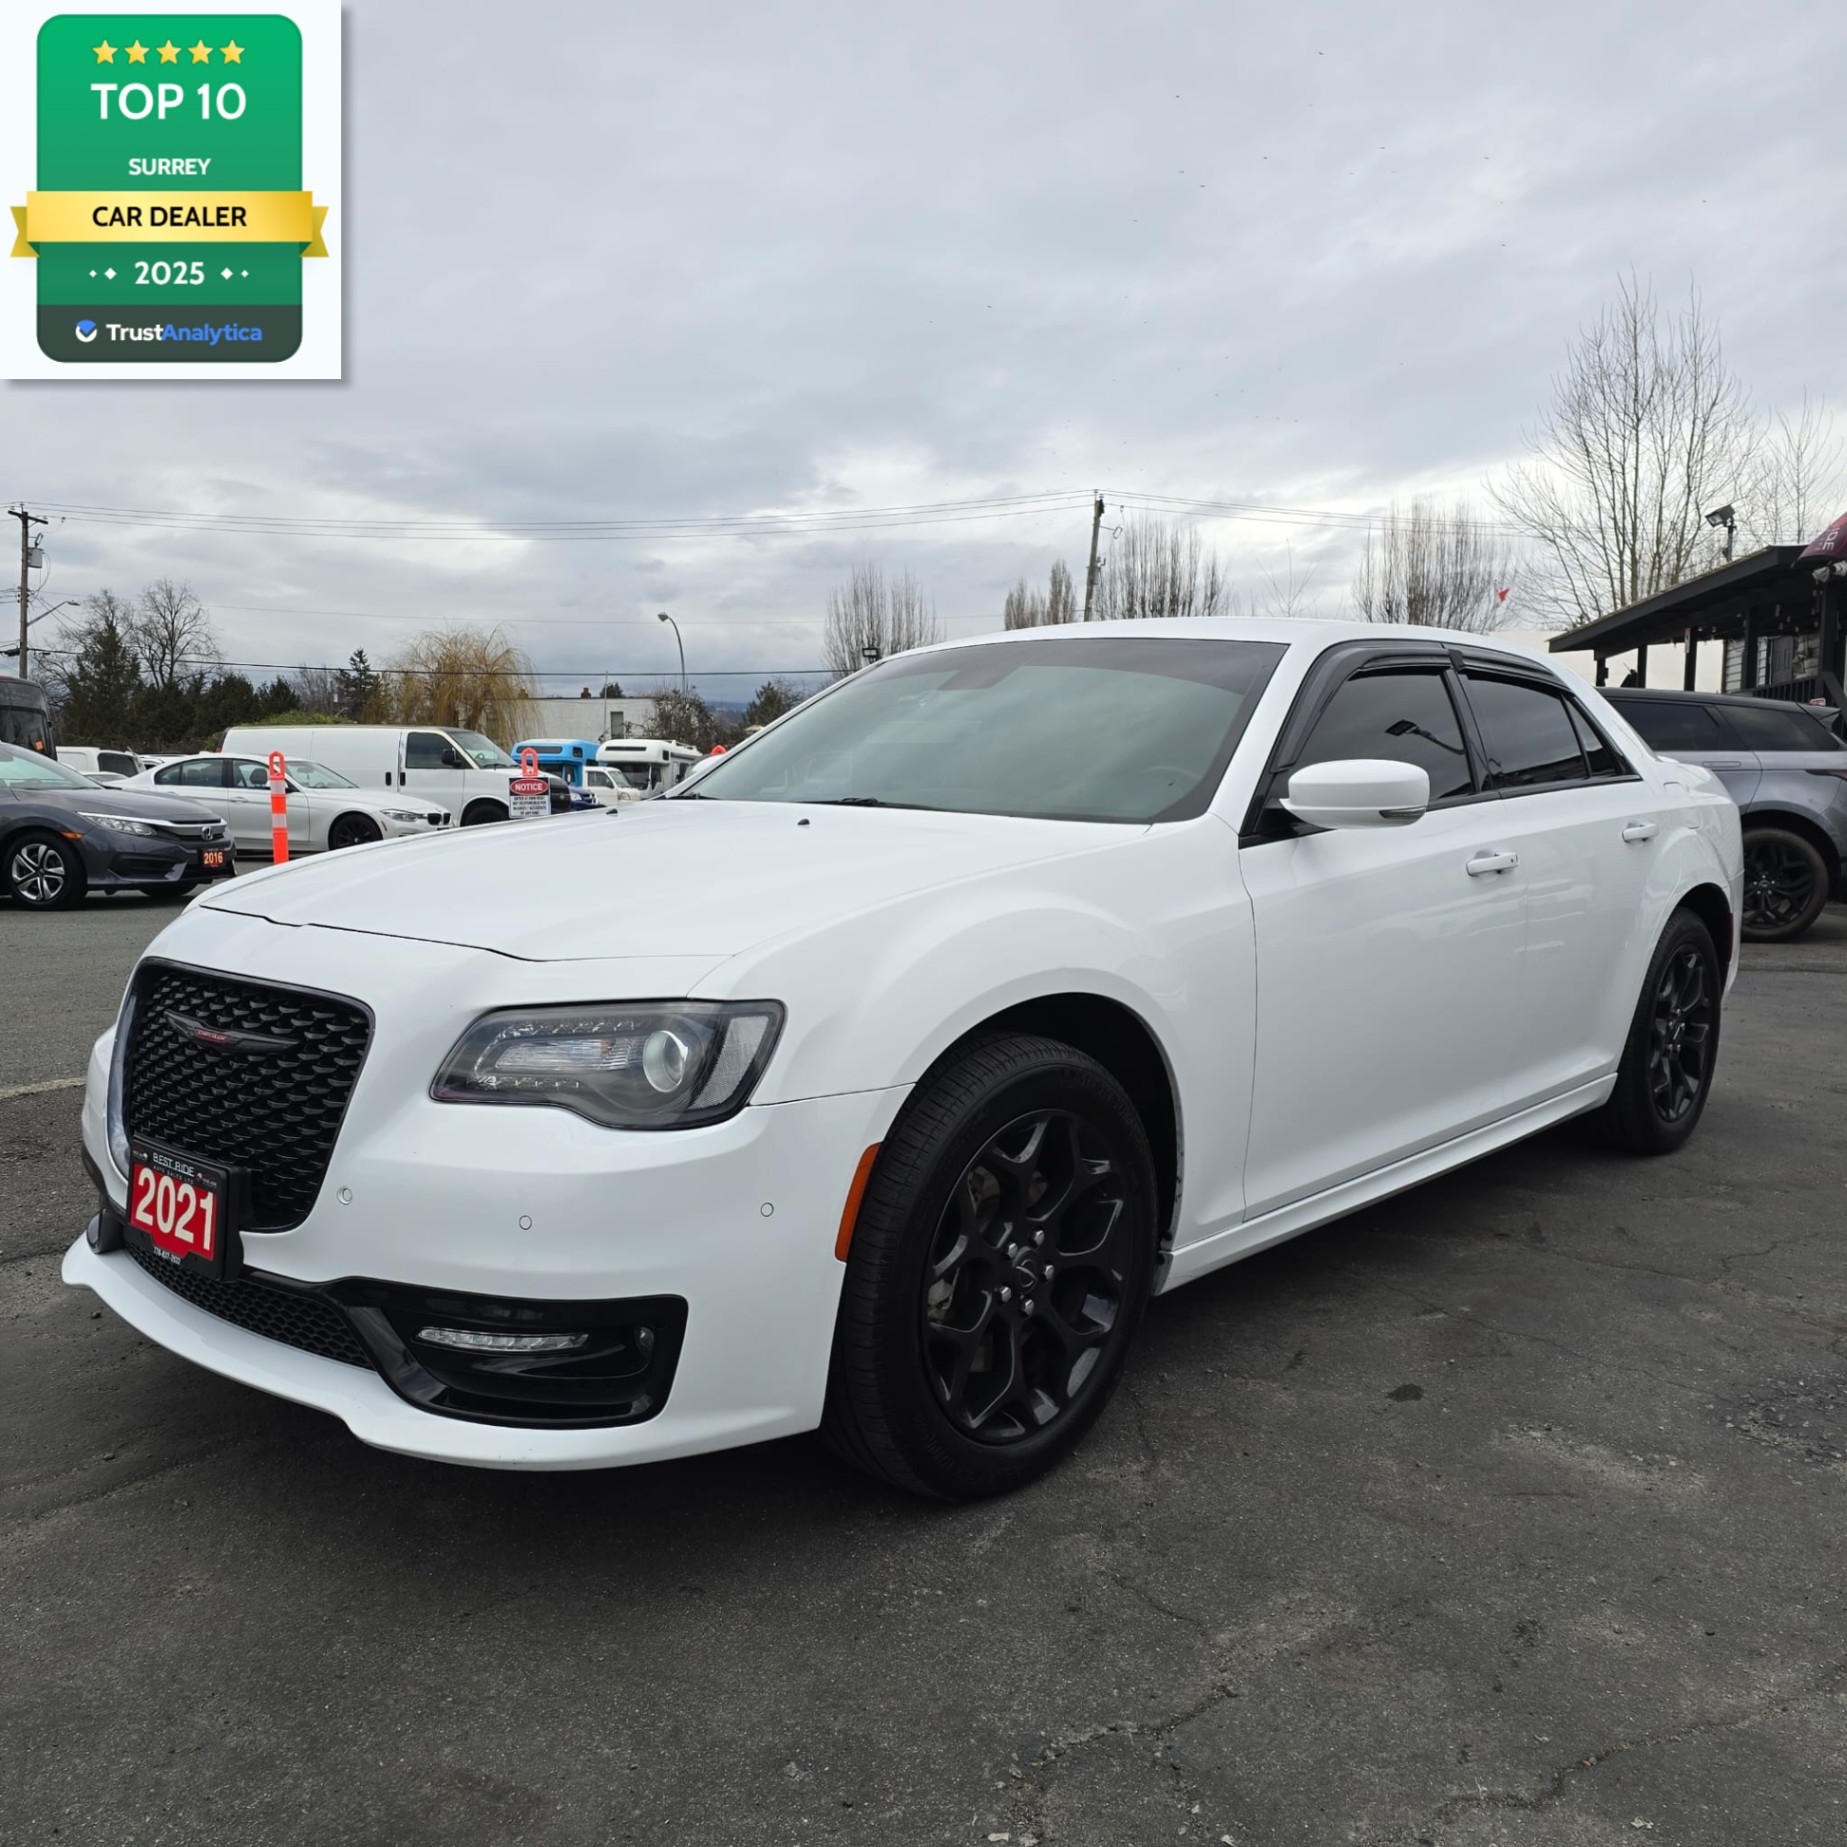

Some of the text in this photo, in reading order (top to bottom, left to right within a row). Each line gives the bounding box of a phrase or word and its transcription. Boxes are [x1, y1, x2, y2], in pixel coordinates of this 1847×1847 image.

[514, 782, 544, 791] NOTICE
[203, 851, 224, 865] 2016
[153, 1152, 173, 1168] BEST
[175, 1161, 194, 1177] RIDE
[135, 1167, 214, 1251] 2021
